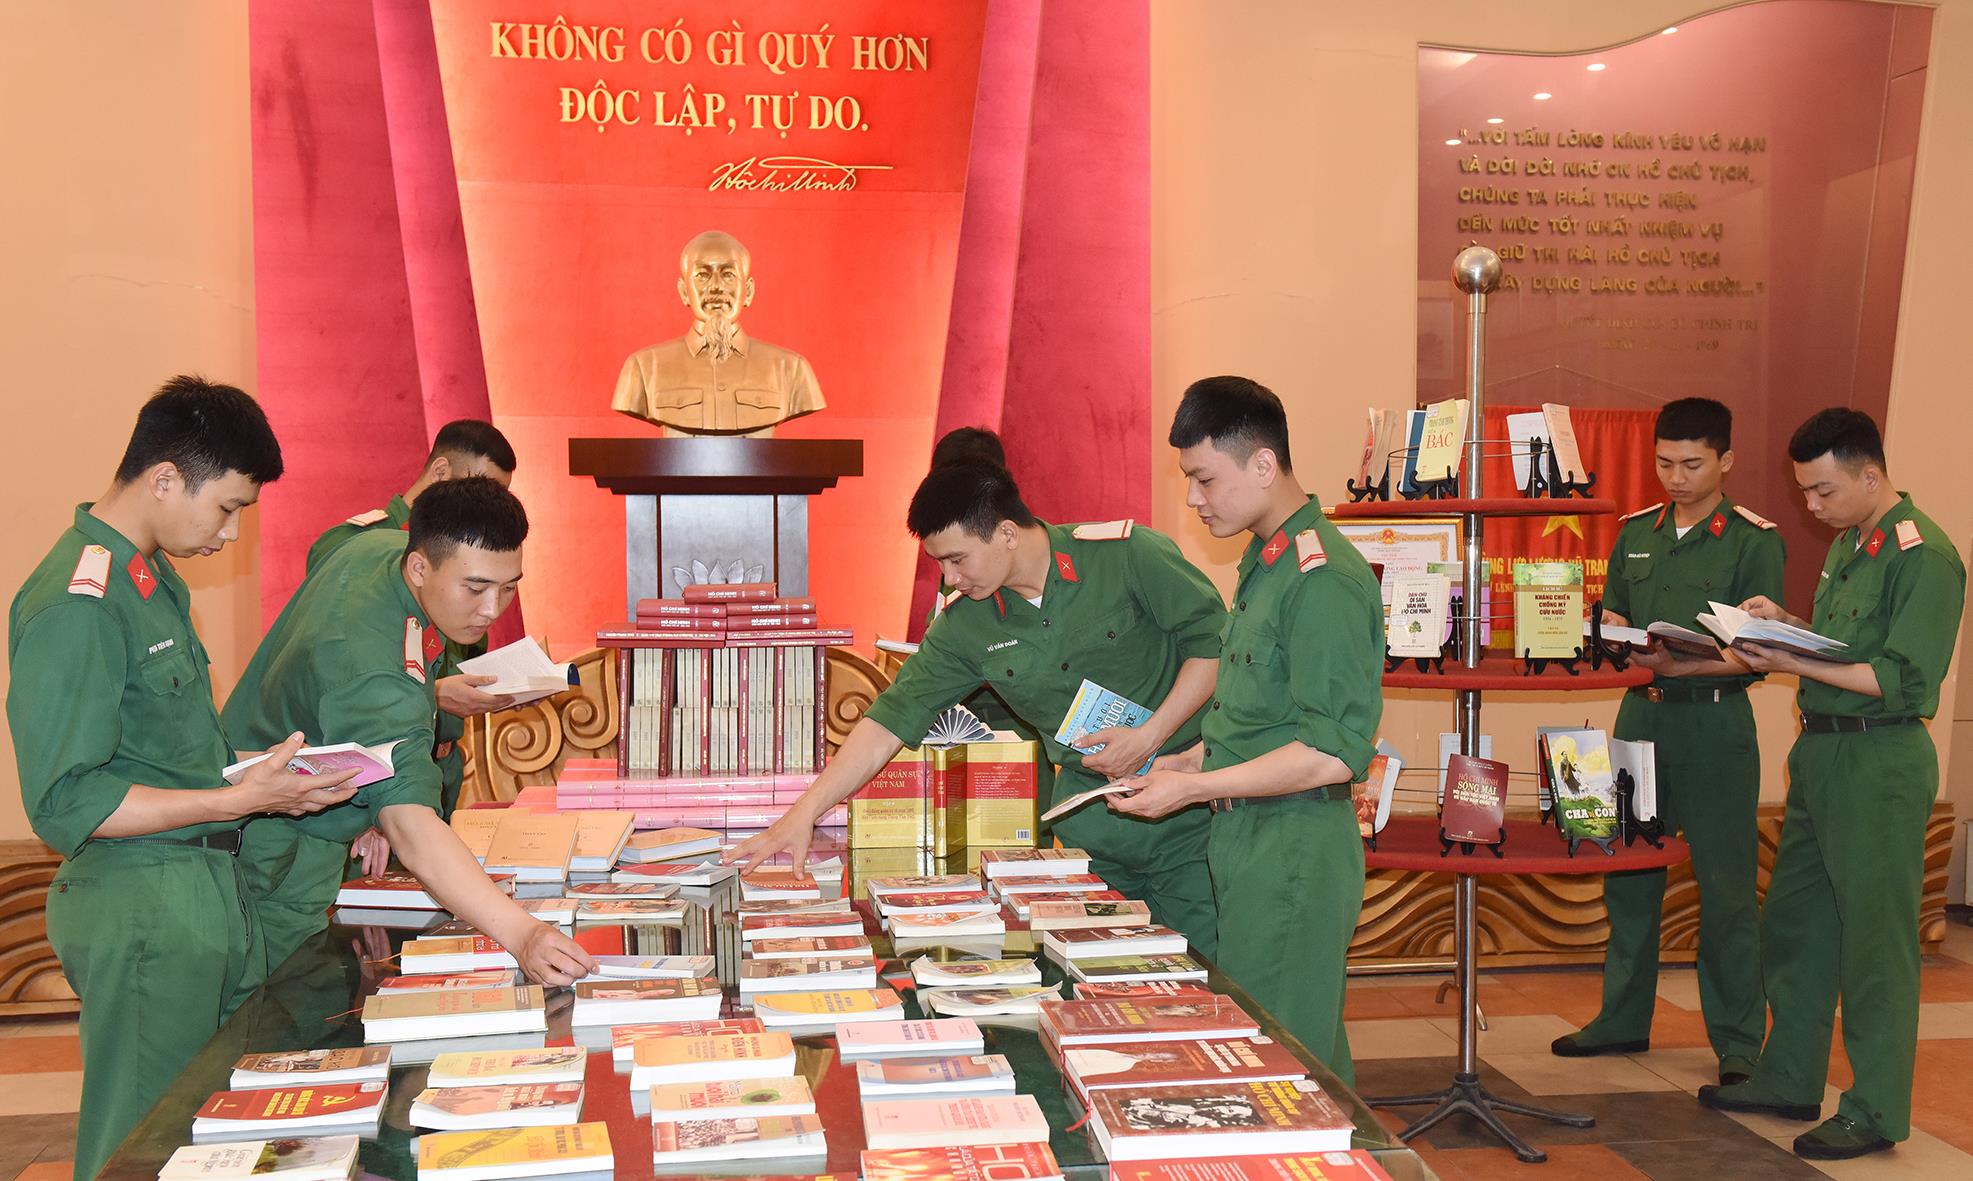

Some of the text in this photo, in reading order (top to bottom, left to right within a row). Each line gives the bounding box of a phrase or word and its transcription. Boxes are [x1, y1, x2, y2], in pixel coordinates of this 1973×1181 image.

[489, 15, 929, 75] KHÔNG CÓ GÌ QUÝ HƠN
[559, 79, 869, 139] ĐỘC LẬP, TỰ DO.
[1514, 126, 1550, 146] TẤM
[1557, 129, 1604, 149] LÒNG
[1612, 132, 1653, 151] KÍNH
[1659, 132, 1694, 151] YÊU
[1699, 132, 1722, 152] VÔ
[1728, 137, 1767, 155] HẠN
[1459, 154, 1481, 173] VÀ
[1637, 158, 1661, 180] HỒ
[1667, 161, 1702, 180] CHỦ
[1458, 184, 1697, 212] CHÚNG TA PHẢI THỰC HIỆN
[1502, 215, 1541, 233] MỨC
[1549, 215, 1580, 233] TỐT
[1587, 214, 1631, 236] NHẤT
[1639, 219, 1694, 240] NHIỆM
[1699, 222, 1724, 242] VỤ
[1533, 247, 1559, 263] THI
[1568, 244, 1598, 264] HÀI
[1606, 243, 1631, 264] HỒ
[1636, 246, 1673, 265] CHỦ
[1680, 250, 1721, 269] TỊCH
[1531, 272, 1583, 293] DỰNG
[1643, 275, 1680, 295] CỦA
[1426, 428, 1454, 449] BÁC
[872, 780, 905, 789] VIỆT NAM
[887, 770, 909, 779] QUÂN
[1565, 809, 1589, 820] CHA
[1595, 807, 1616, 818] CON
